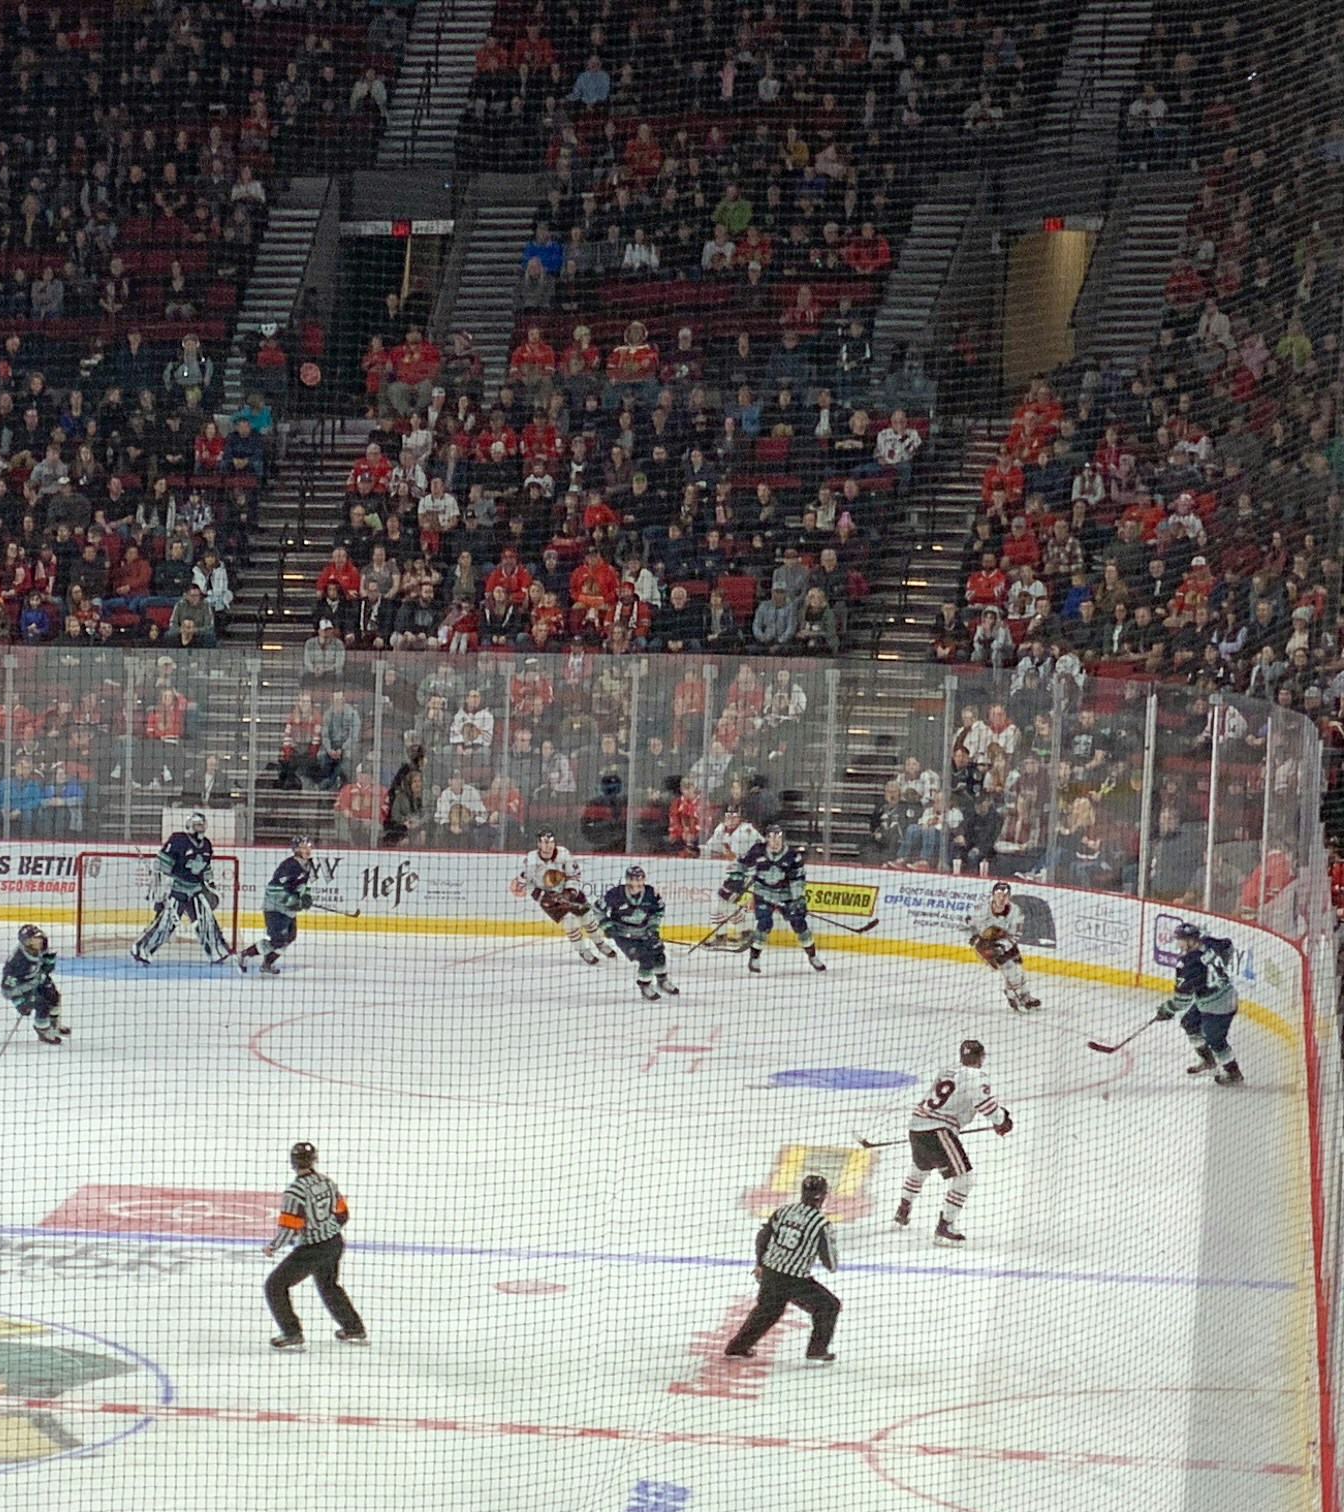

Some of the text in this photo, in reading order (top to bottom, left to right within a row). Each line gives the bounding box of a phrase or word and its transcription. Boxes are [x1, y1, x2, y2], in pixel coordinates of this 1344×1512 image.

[361, 860, 419, 909] Hefe
[814, 889, 871, 909] SCHWAB
[884, 895, 922, 907] OPEN
